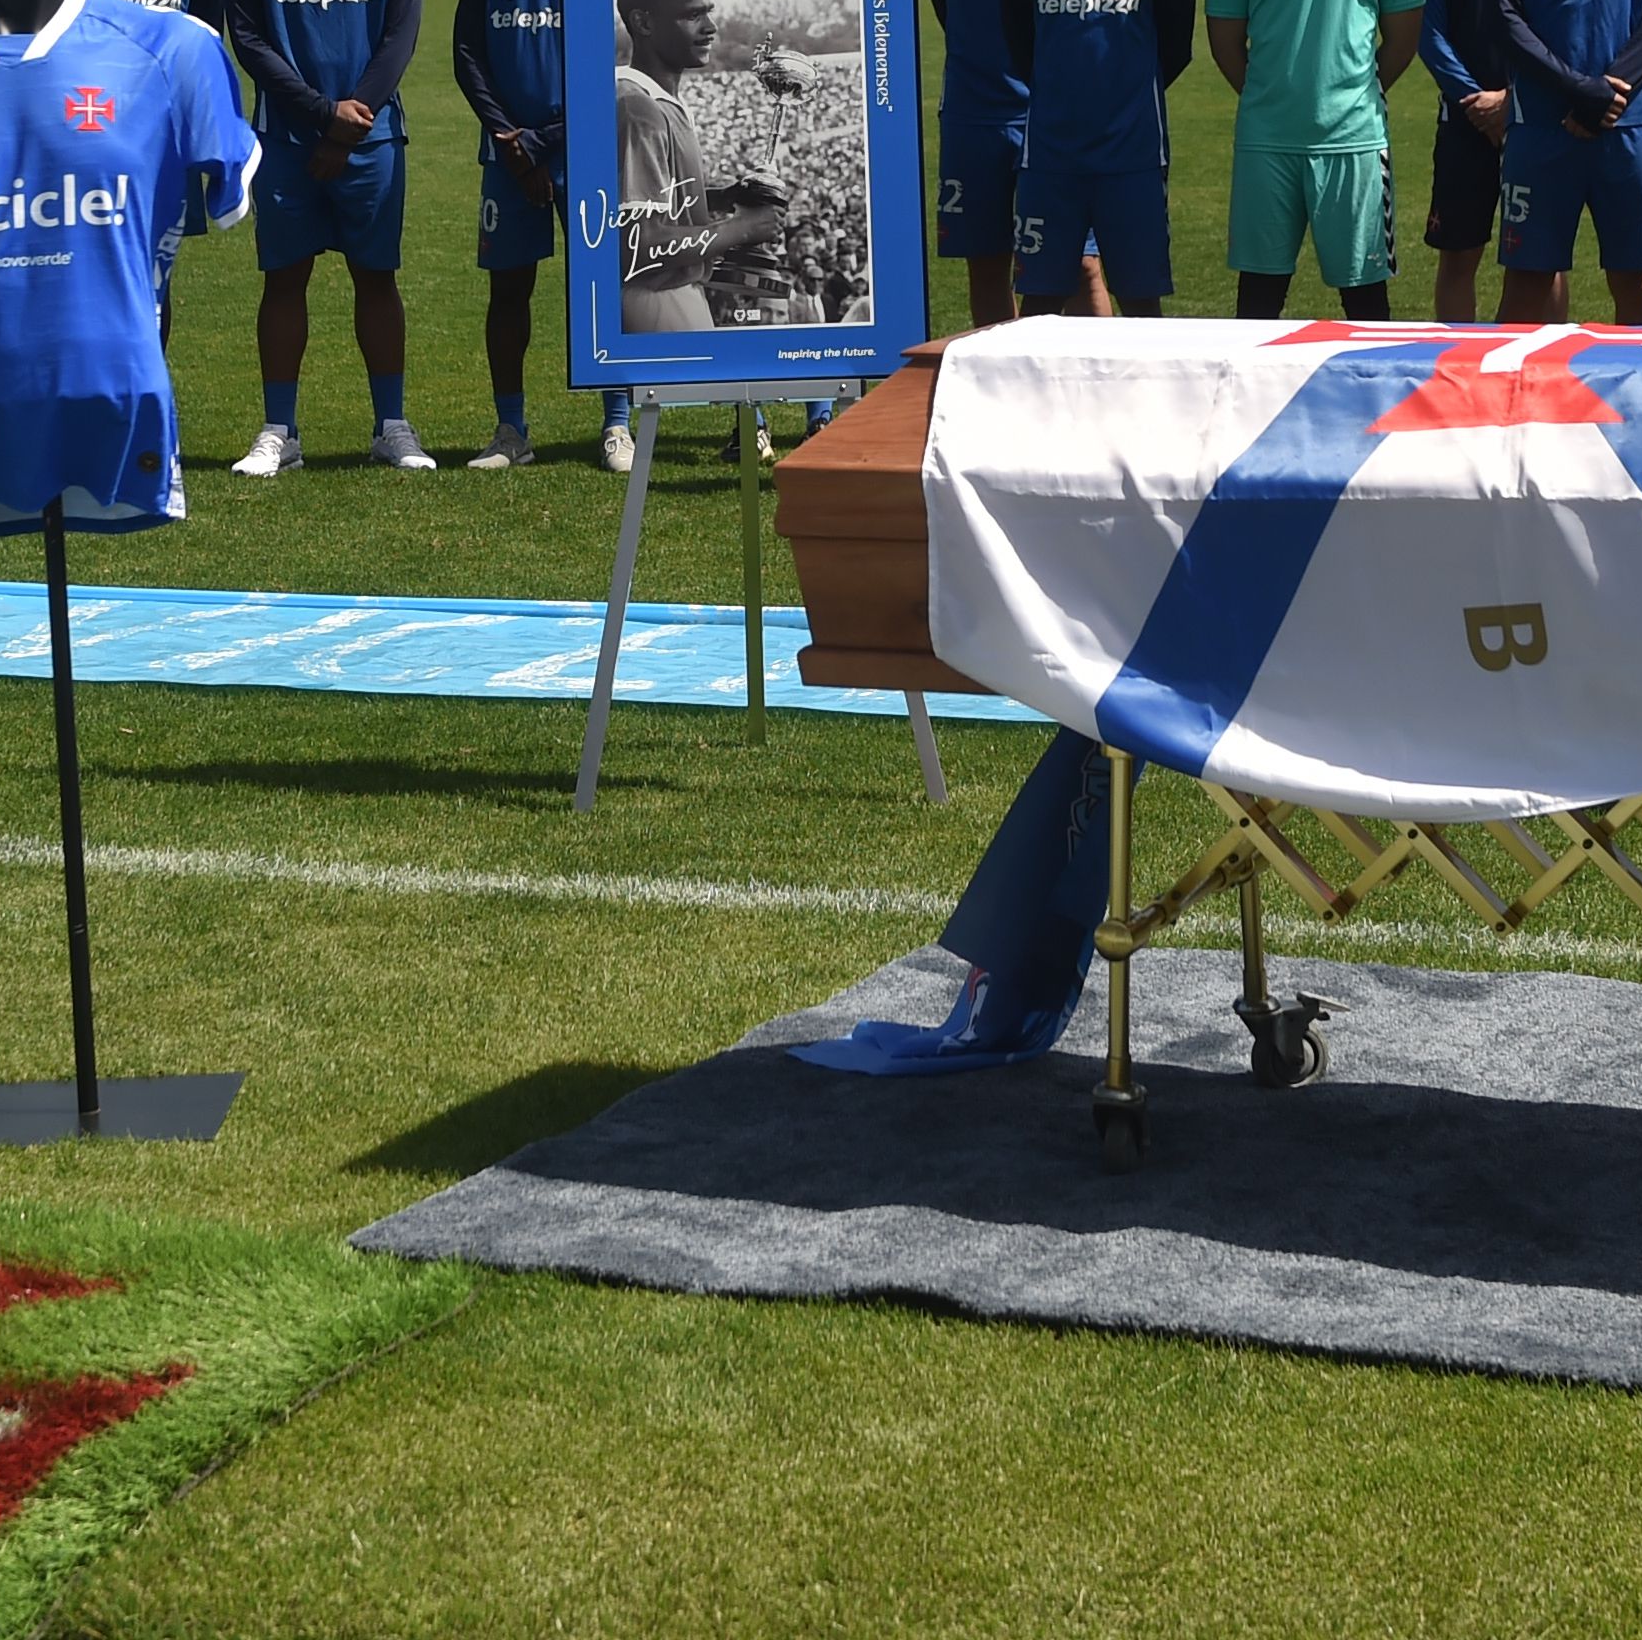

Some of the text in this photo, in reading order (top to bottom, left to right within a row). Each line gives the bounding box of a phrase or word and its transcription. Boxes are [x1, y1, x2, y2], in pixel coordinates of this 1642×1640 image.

[490, 7, 561, 34] telepi
[579, 177, 698, 250] Vicente
[623, 221, 719, 283] Lucas
[778, 346, 877, 360] Inspiring the future.
[1463, 602, 1549, 672] B
